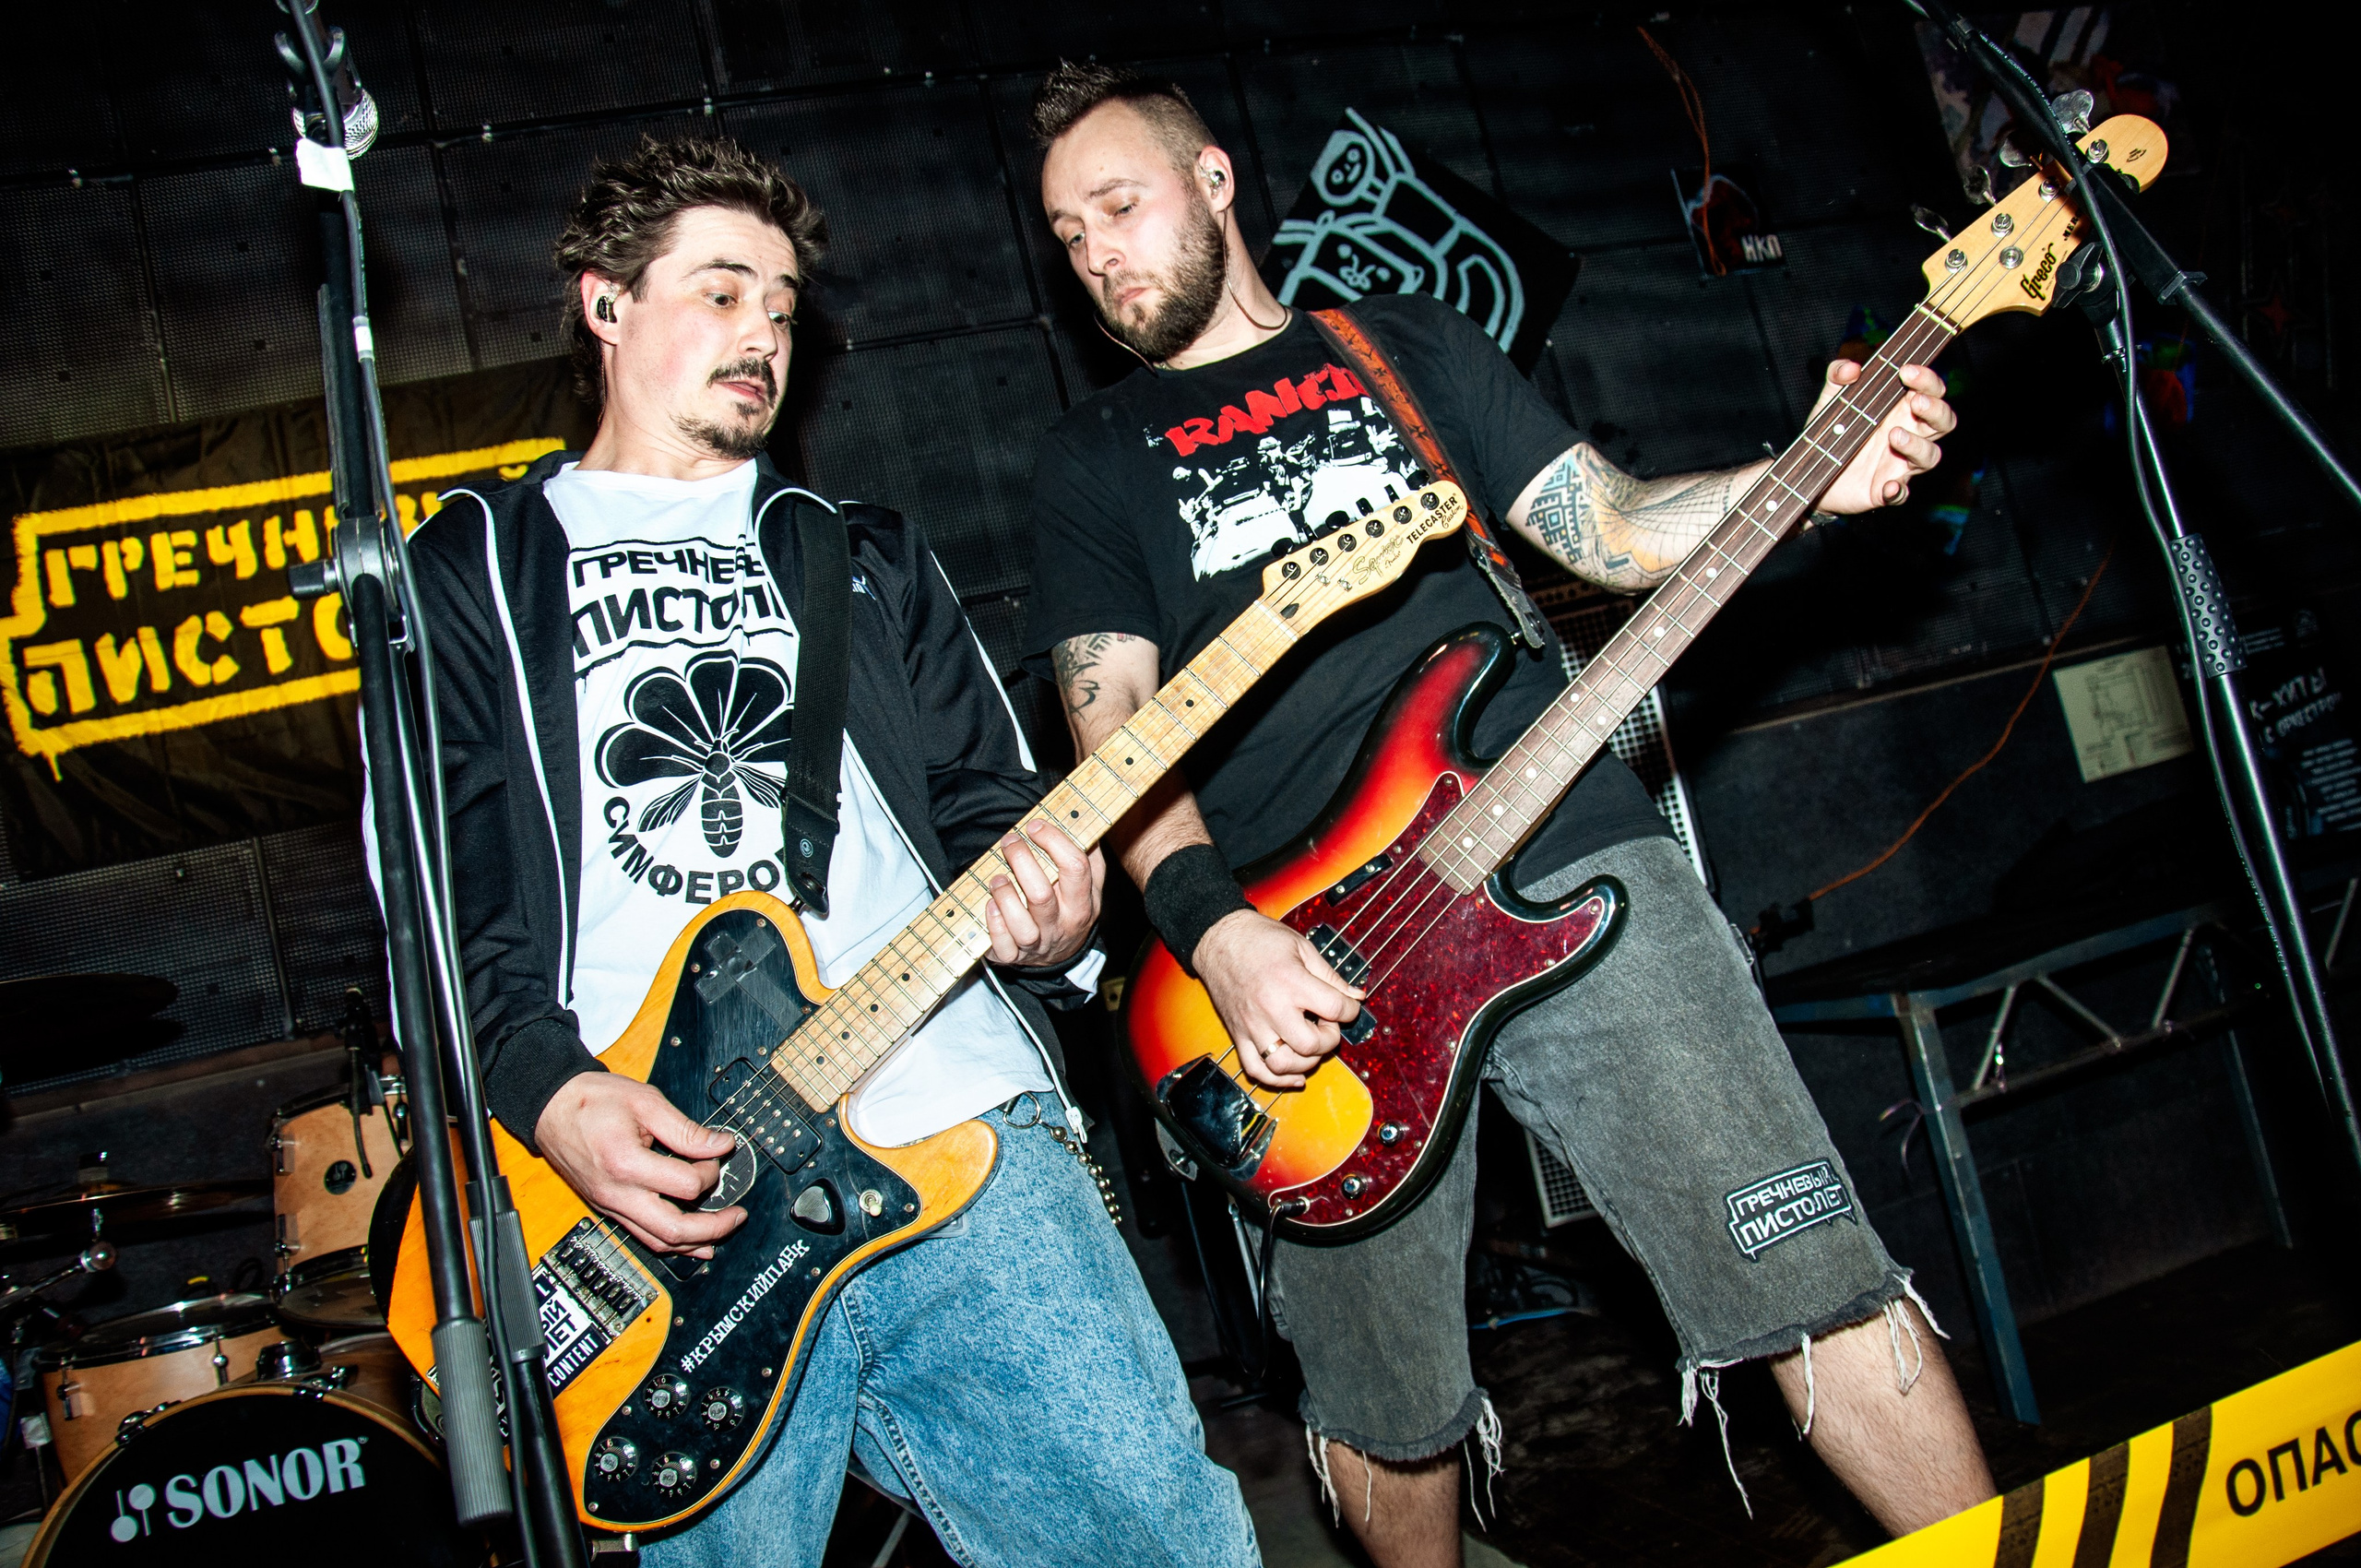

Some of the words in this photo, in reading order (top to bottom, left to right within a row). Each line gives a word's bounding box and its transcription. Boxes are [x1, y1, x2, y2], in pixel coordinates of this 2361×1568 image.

[2020, 243, 2058, 301] Greco
[1406, 495, 1458, 544] TELECASTER
[23, 594, 355, 716] ПИСТО
[571, 582, 787, 659] ПИСТОЛ
[603, 796, 785, 905] СИМФЕРО
[1736, 1166, 1834, 1217] ГРЕЧНЕВЫЙ
[1738, 1184, 1842, 1246] ПИСТОЛЕТ
[681, 1239, 810, 1373] #КРЫМСКИЙПАНК
[547, 1334, 599, 1387] CONTENT
[164, 1437, 366, 1529] SONOR
